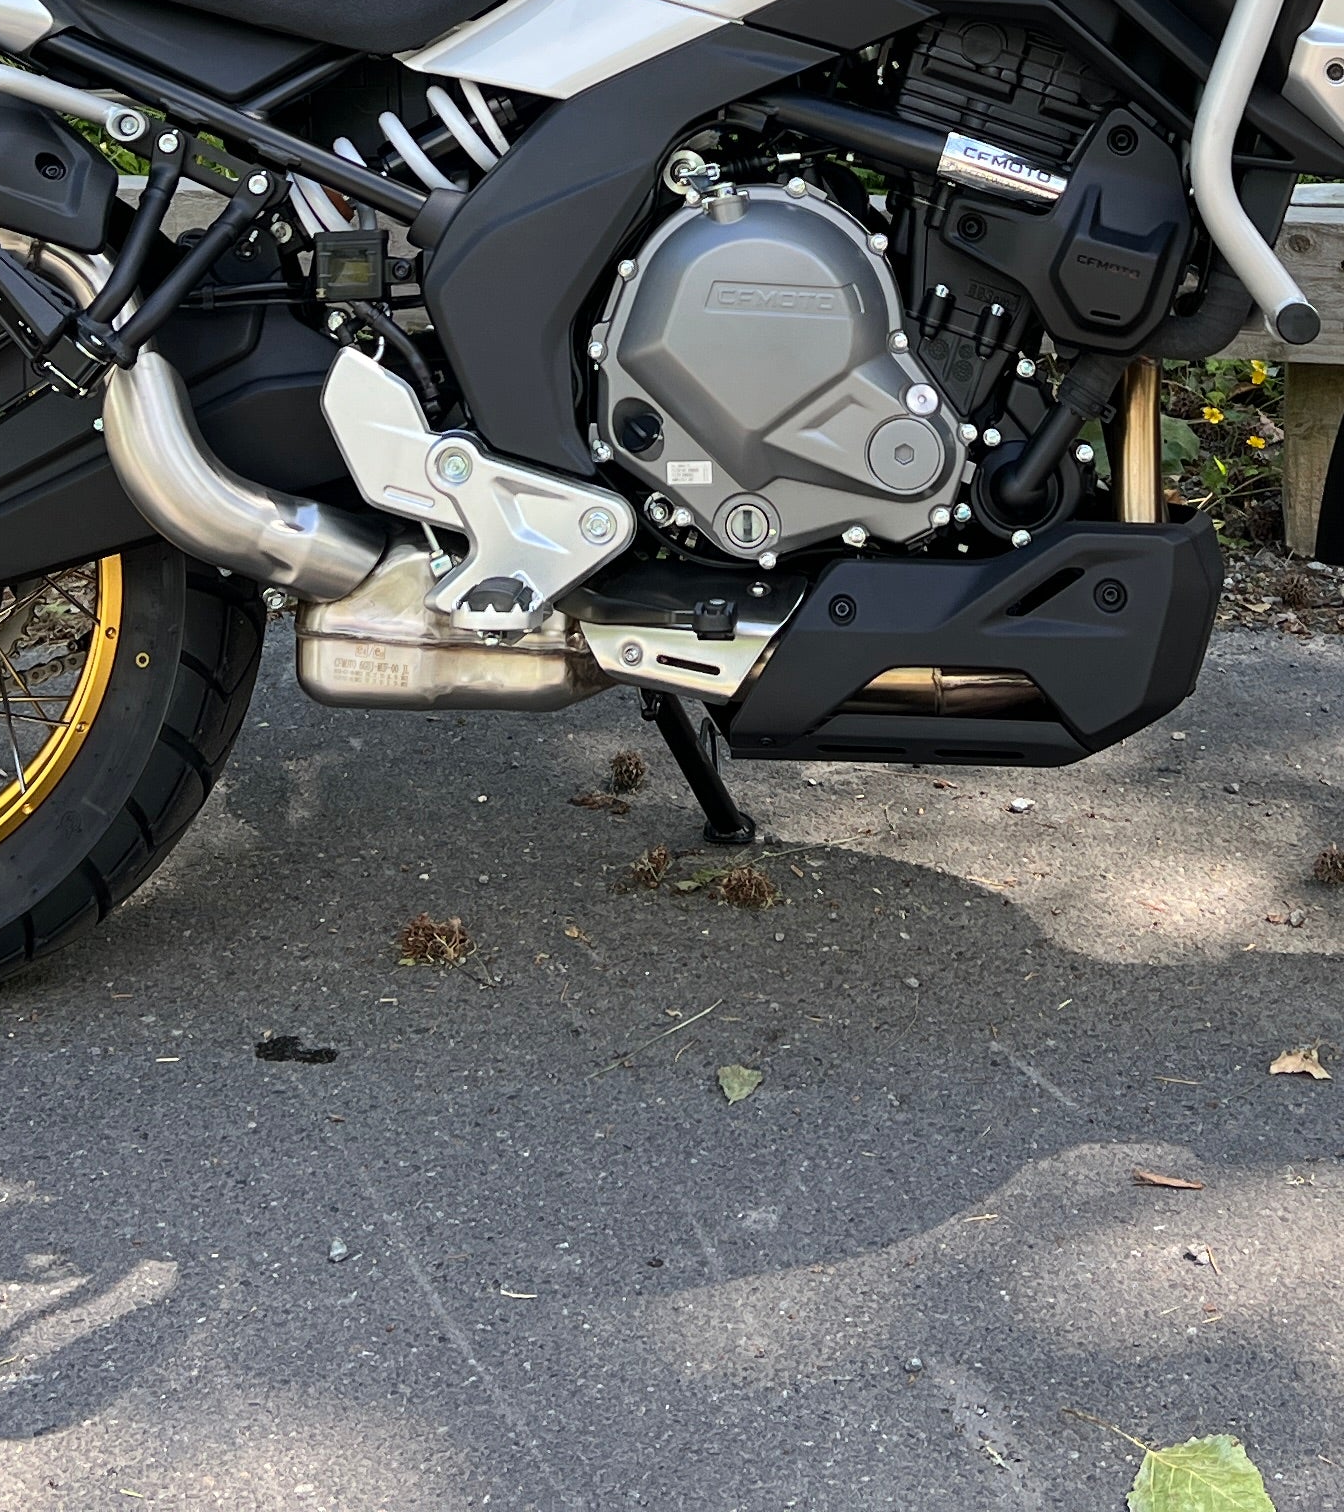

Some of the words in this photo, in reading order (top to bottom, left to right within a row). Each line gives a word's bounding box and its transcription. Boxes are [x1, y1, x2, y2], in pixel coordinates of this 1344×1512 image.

[962, 145, 1053, 184] CFMOTO
[1076, 253, 1142, 280] CFMOTO
[717, 287, 836, 310] CFMOTO
